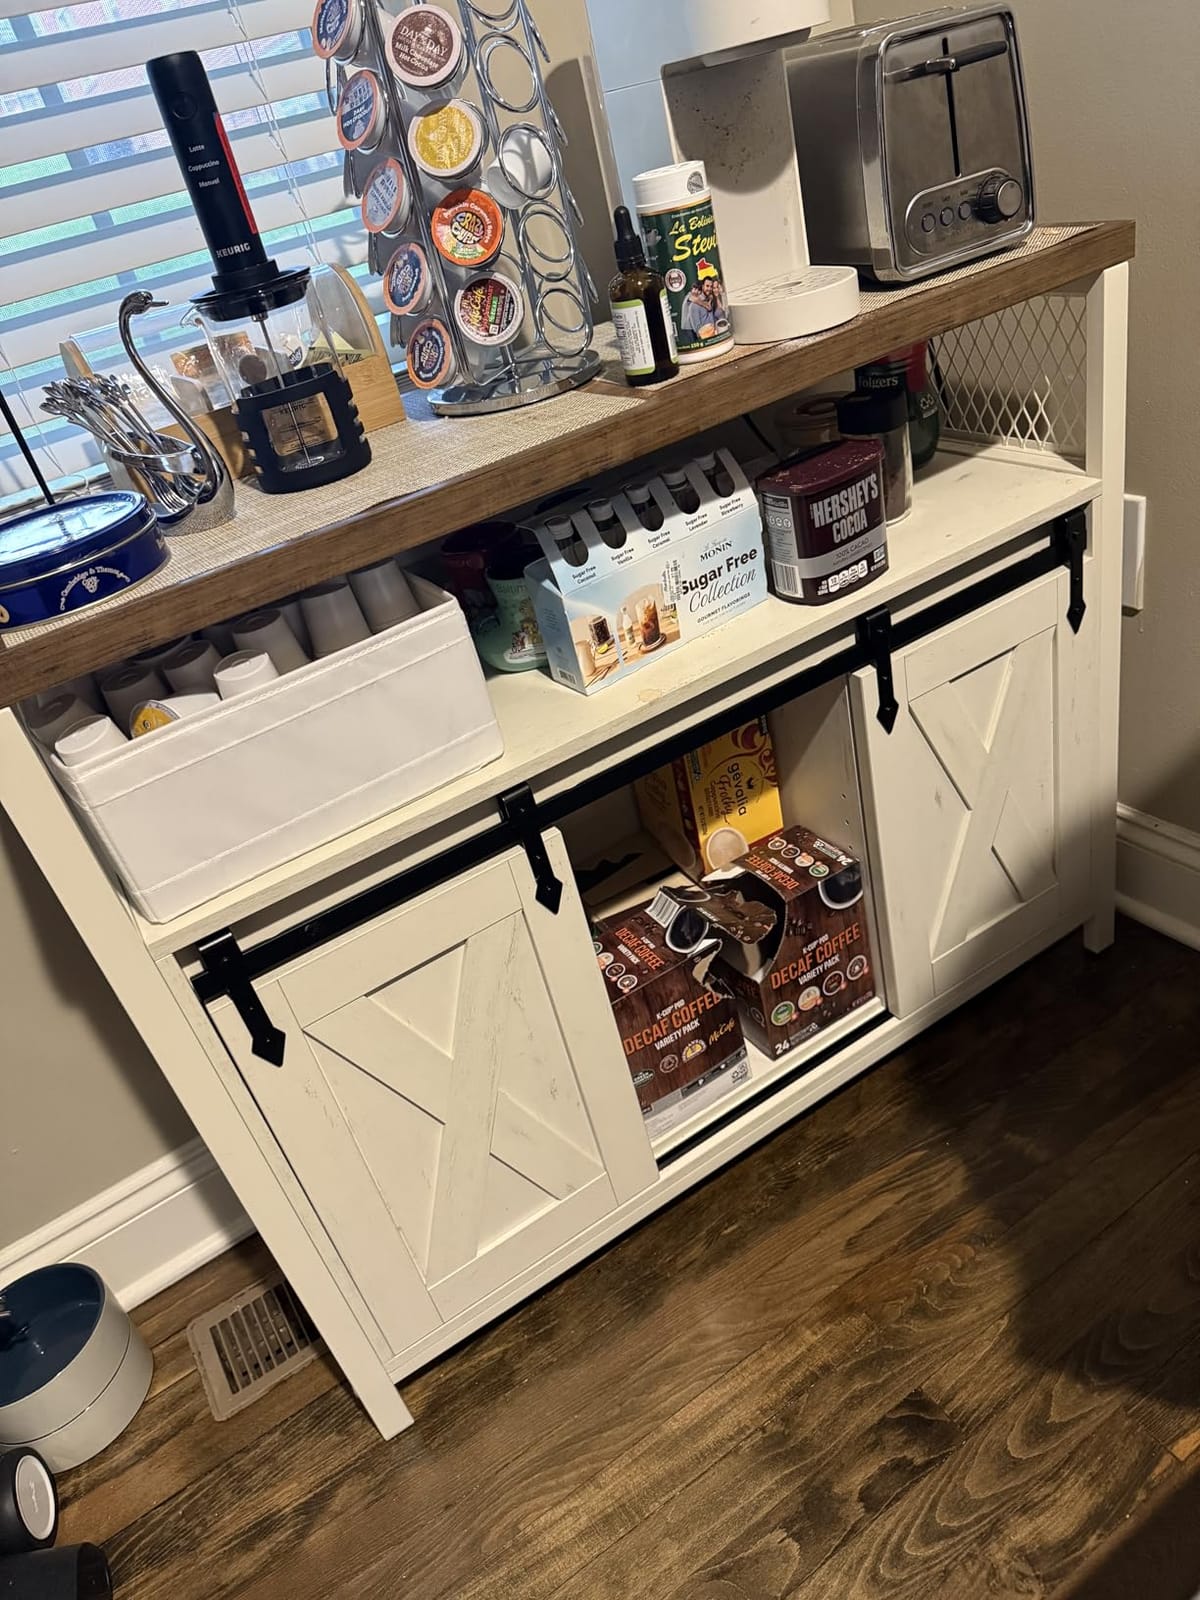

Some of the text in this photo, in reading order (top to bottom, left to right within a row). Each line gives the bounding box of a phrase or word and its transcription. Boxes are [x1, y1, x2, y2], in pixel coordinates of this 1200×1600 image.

[400, 26, 420, 41] DAY
[426, 40, 448, 57] DAY
[189, 144, 205, 153] Latte
[188, 160, 220, 172] Cappuccino
[198, 178, 220, 188] Manual
[451, 221, 480, 244] CUPS
[455, 212, 485, 237] CRAZY
[669, 220, 686, 235] La
[216, 243, 251, 258] KEURIG
[720, 497, 741, 510] Sugar Free
[721, 503, 744, 516] Strawberry
[812, 473, 879, 529] HERSHEY'S
[685, 513, 708, 526] Sugar Free
[832, 508, 868, 543] COCOA
[647, 530, 670, 544] Sugar Free
[611, 547, 634, 561] Sugar Free
[700, 541, 733, 561] MONIN
[572, 565, 596, 579] Sugar Free
[681, 565, 723, 595] Sugar
[726, 548, 758, 572] Free
[689, 568, 756, 613] Collection
[697, 607, 721, 623] GOURMET
[721, 592, 751, 610] FLAVORINGS
[615, 927, 642, 952] DECAF
[634, 944, 665, 970] COFFEE
[770, 922, 861, 990] DECAF COFFEE
[798, 953, 841, 985] VARIETY PACK
[623, 1018, 670, 1056] DECAF
[654, 1018, 701, 1051] VARIETY PACK
[775, 1039, 790, 1055] 24
